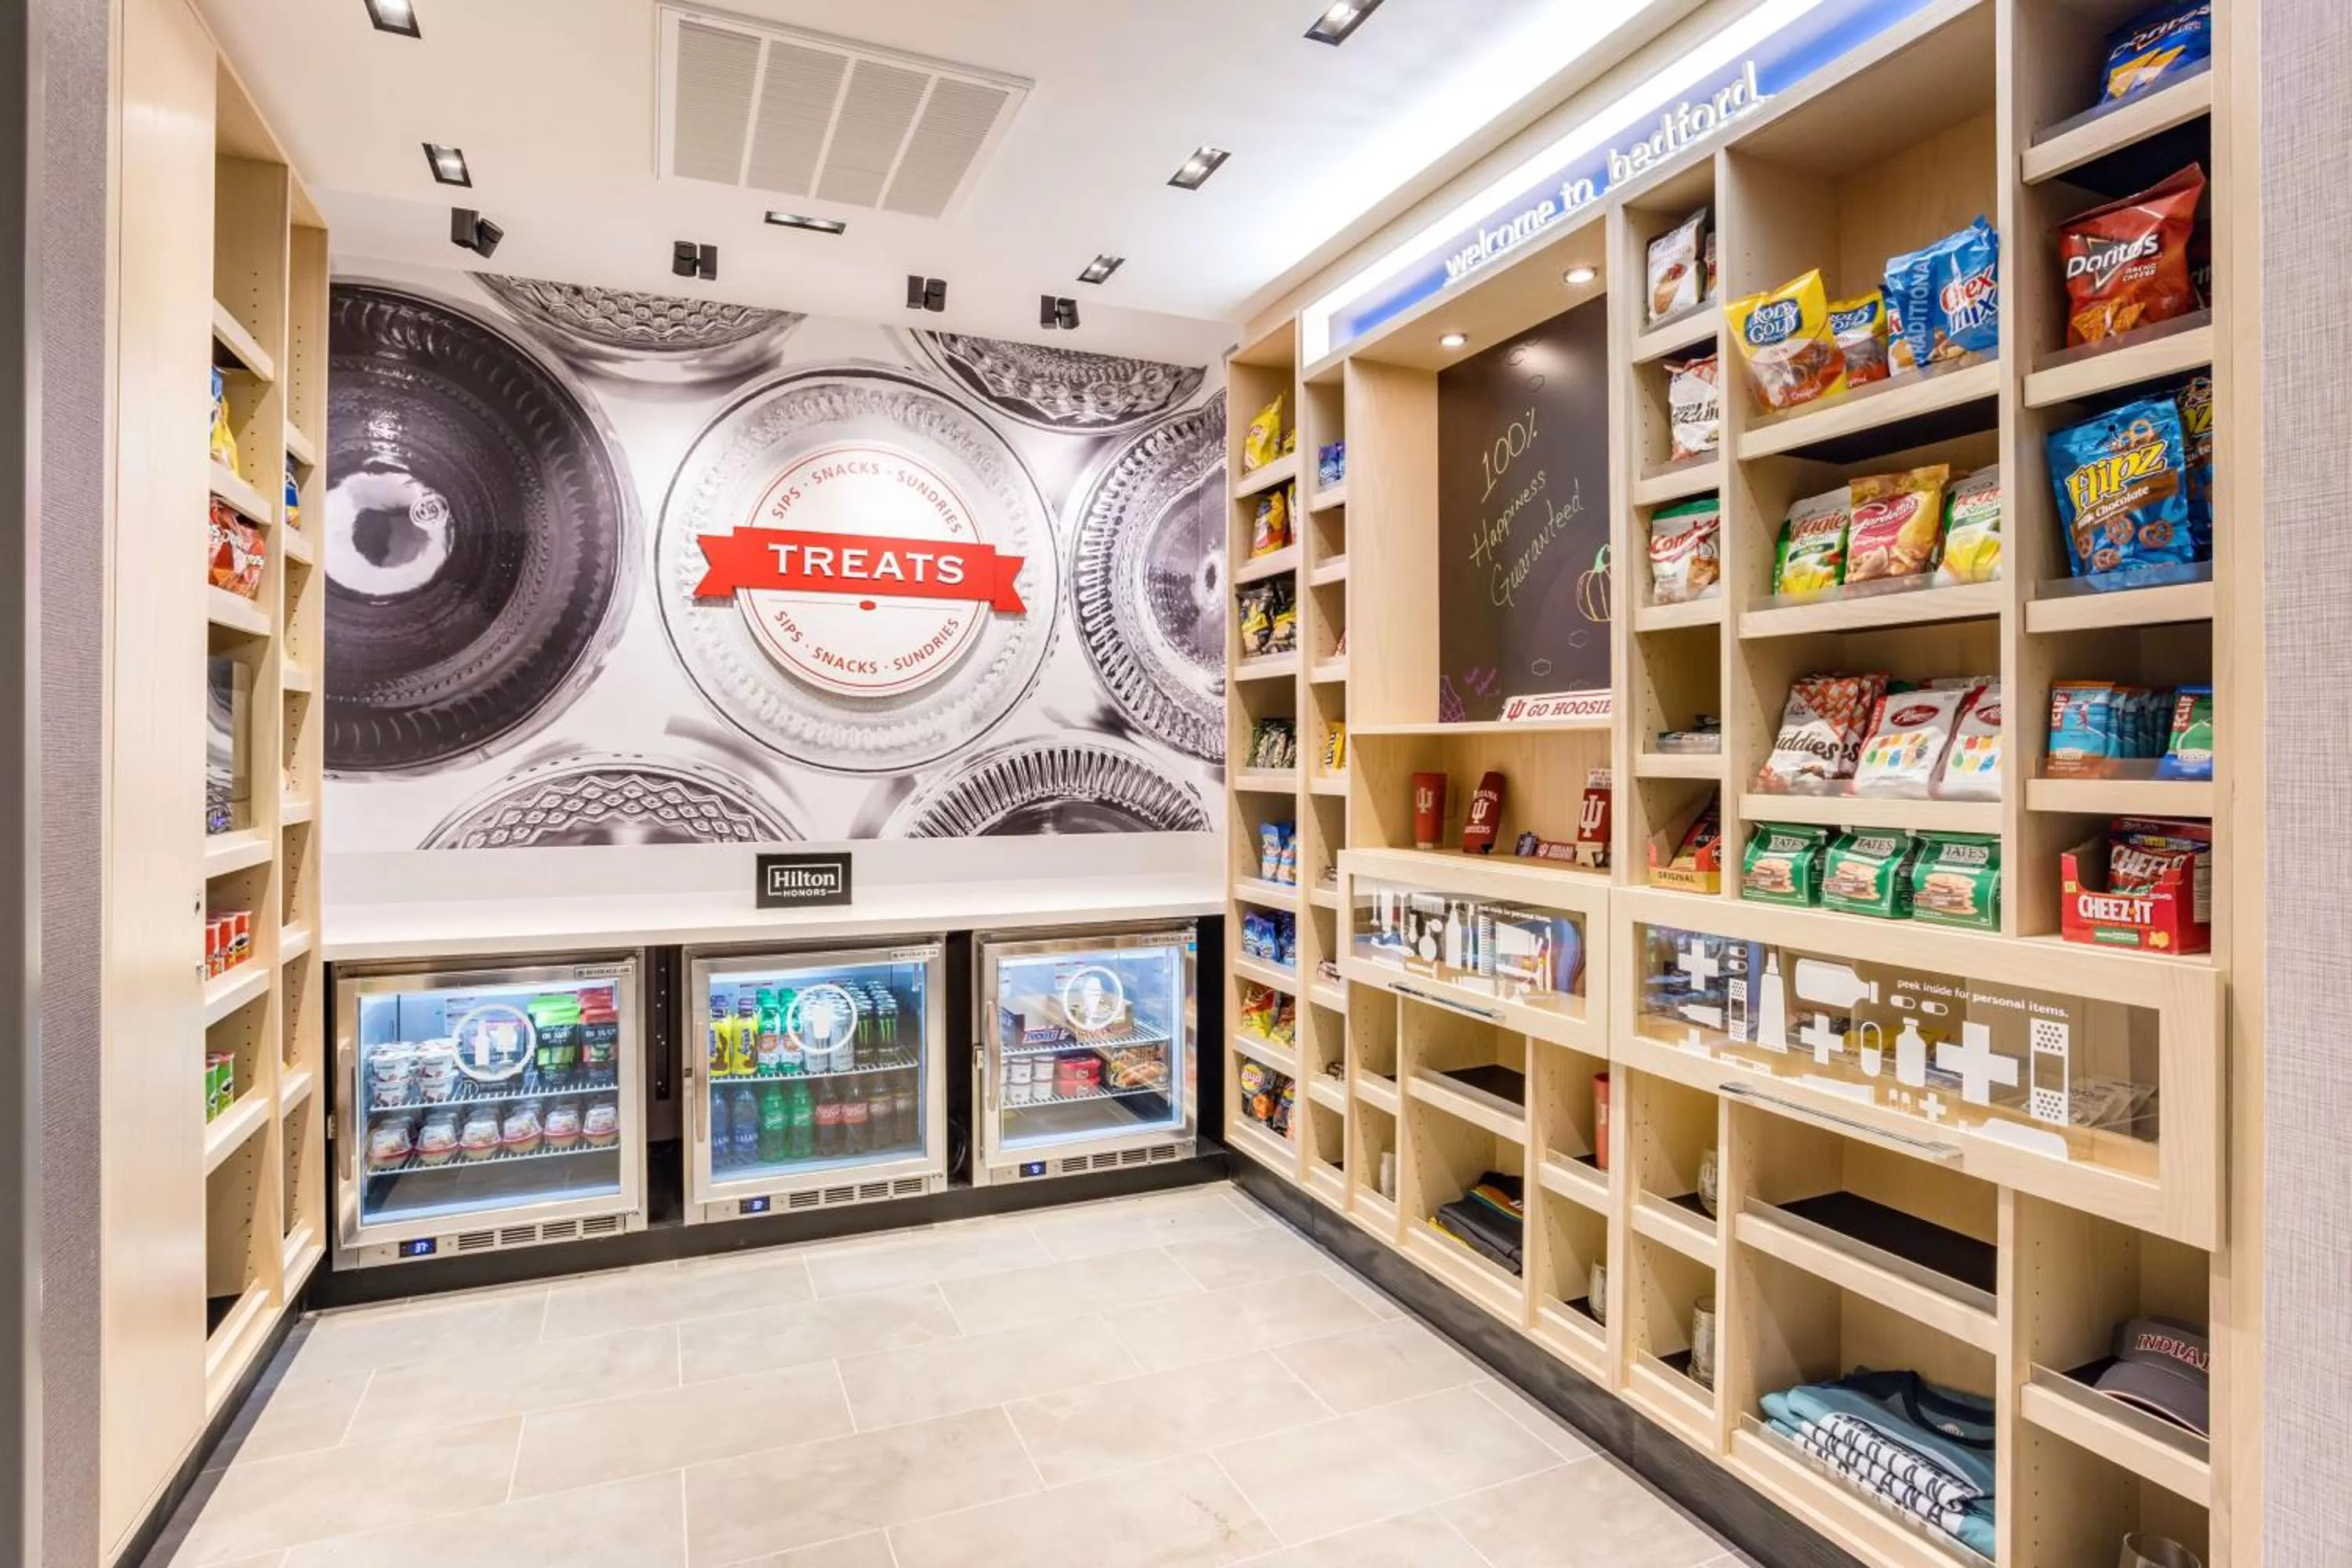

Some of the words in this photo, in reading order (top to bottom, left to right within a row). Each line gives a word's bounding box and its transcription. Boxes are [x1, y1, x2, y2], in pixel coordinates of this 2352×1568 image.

[1445, 201, 1556, 278] welcome
[1561, 178, 1594, 212] to
[1607, 61, 1757, 185] bedford
[2067, 234, 2158, 280] Doritos
[1940, 263, 1995, 310] Chex
[1749, 317, 1795, 343] GOLD
[1480, 407, 1537, 503] 100%
[771, 486, 801, 519] SIPS
[811, 461, 880, 485] SNACKS
[896, 470, 963, 534] SUNDRIES
[768, 543, 965, 585] TREATS
[774, 610, 804, 643] SIPS
[812, 647, 878, 674] SNACKS
[893, 618, 960, 671] SUNDRIES
[1527, 703, 1549, 717] GO
[773, 870, 835, 887] Hilton
[783, 888, 827, 897] HONORS
[1658, 870, 1696, 883] ORIGINAL
[1897, 979, 1921, 991] peek
[1923, 983, 1953, 996] inside
[1955, 988, 1970, 1000] for
[1973, 993, 2025, 1010] personal
[2029, 1000, 2070, 1018] items.
